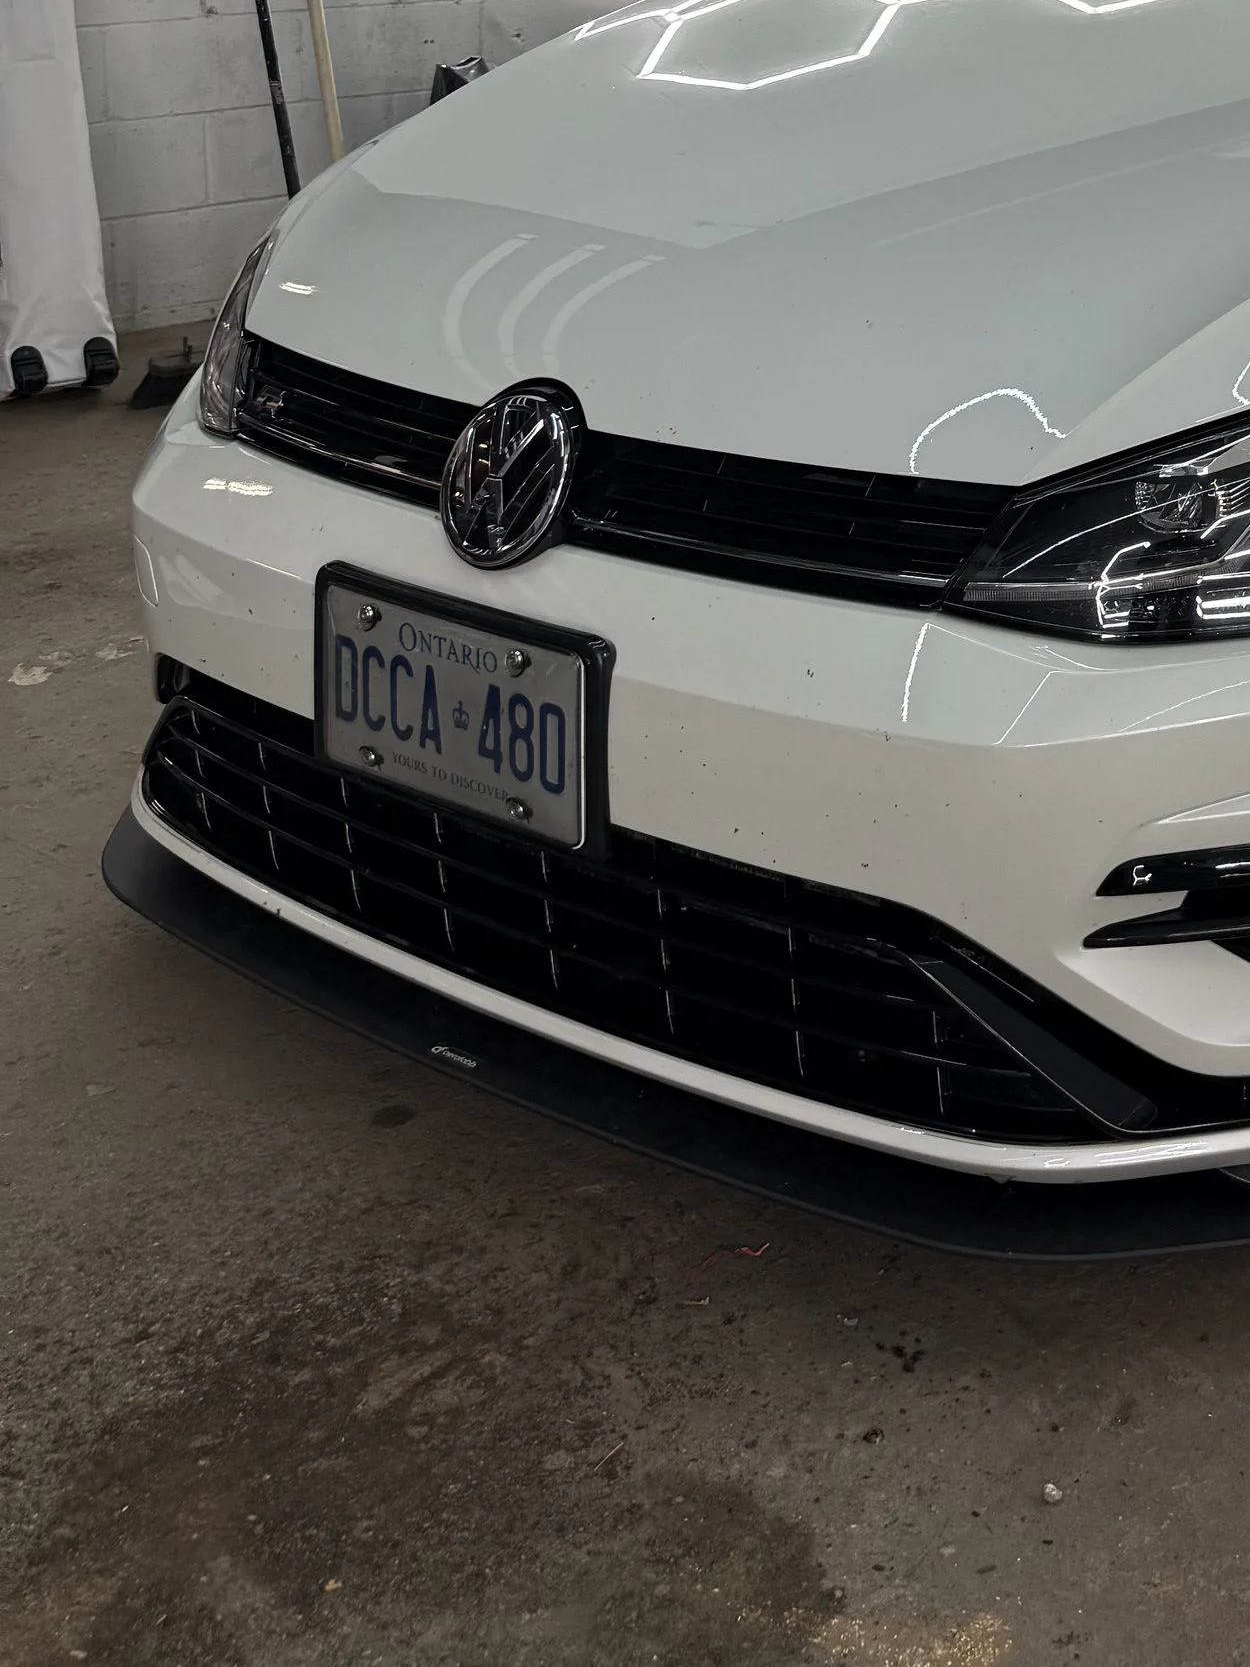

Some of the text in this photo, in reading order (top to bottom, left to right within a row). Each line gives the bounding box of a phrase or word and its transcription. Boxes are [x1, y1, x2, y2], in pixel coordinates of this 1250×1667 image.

[398, 623, 497, 674] ONTARIO
[334, 634, 566, 795] DCCA 480
[391, 750, 509, 802] YOURS TO DISCOVER
